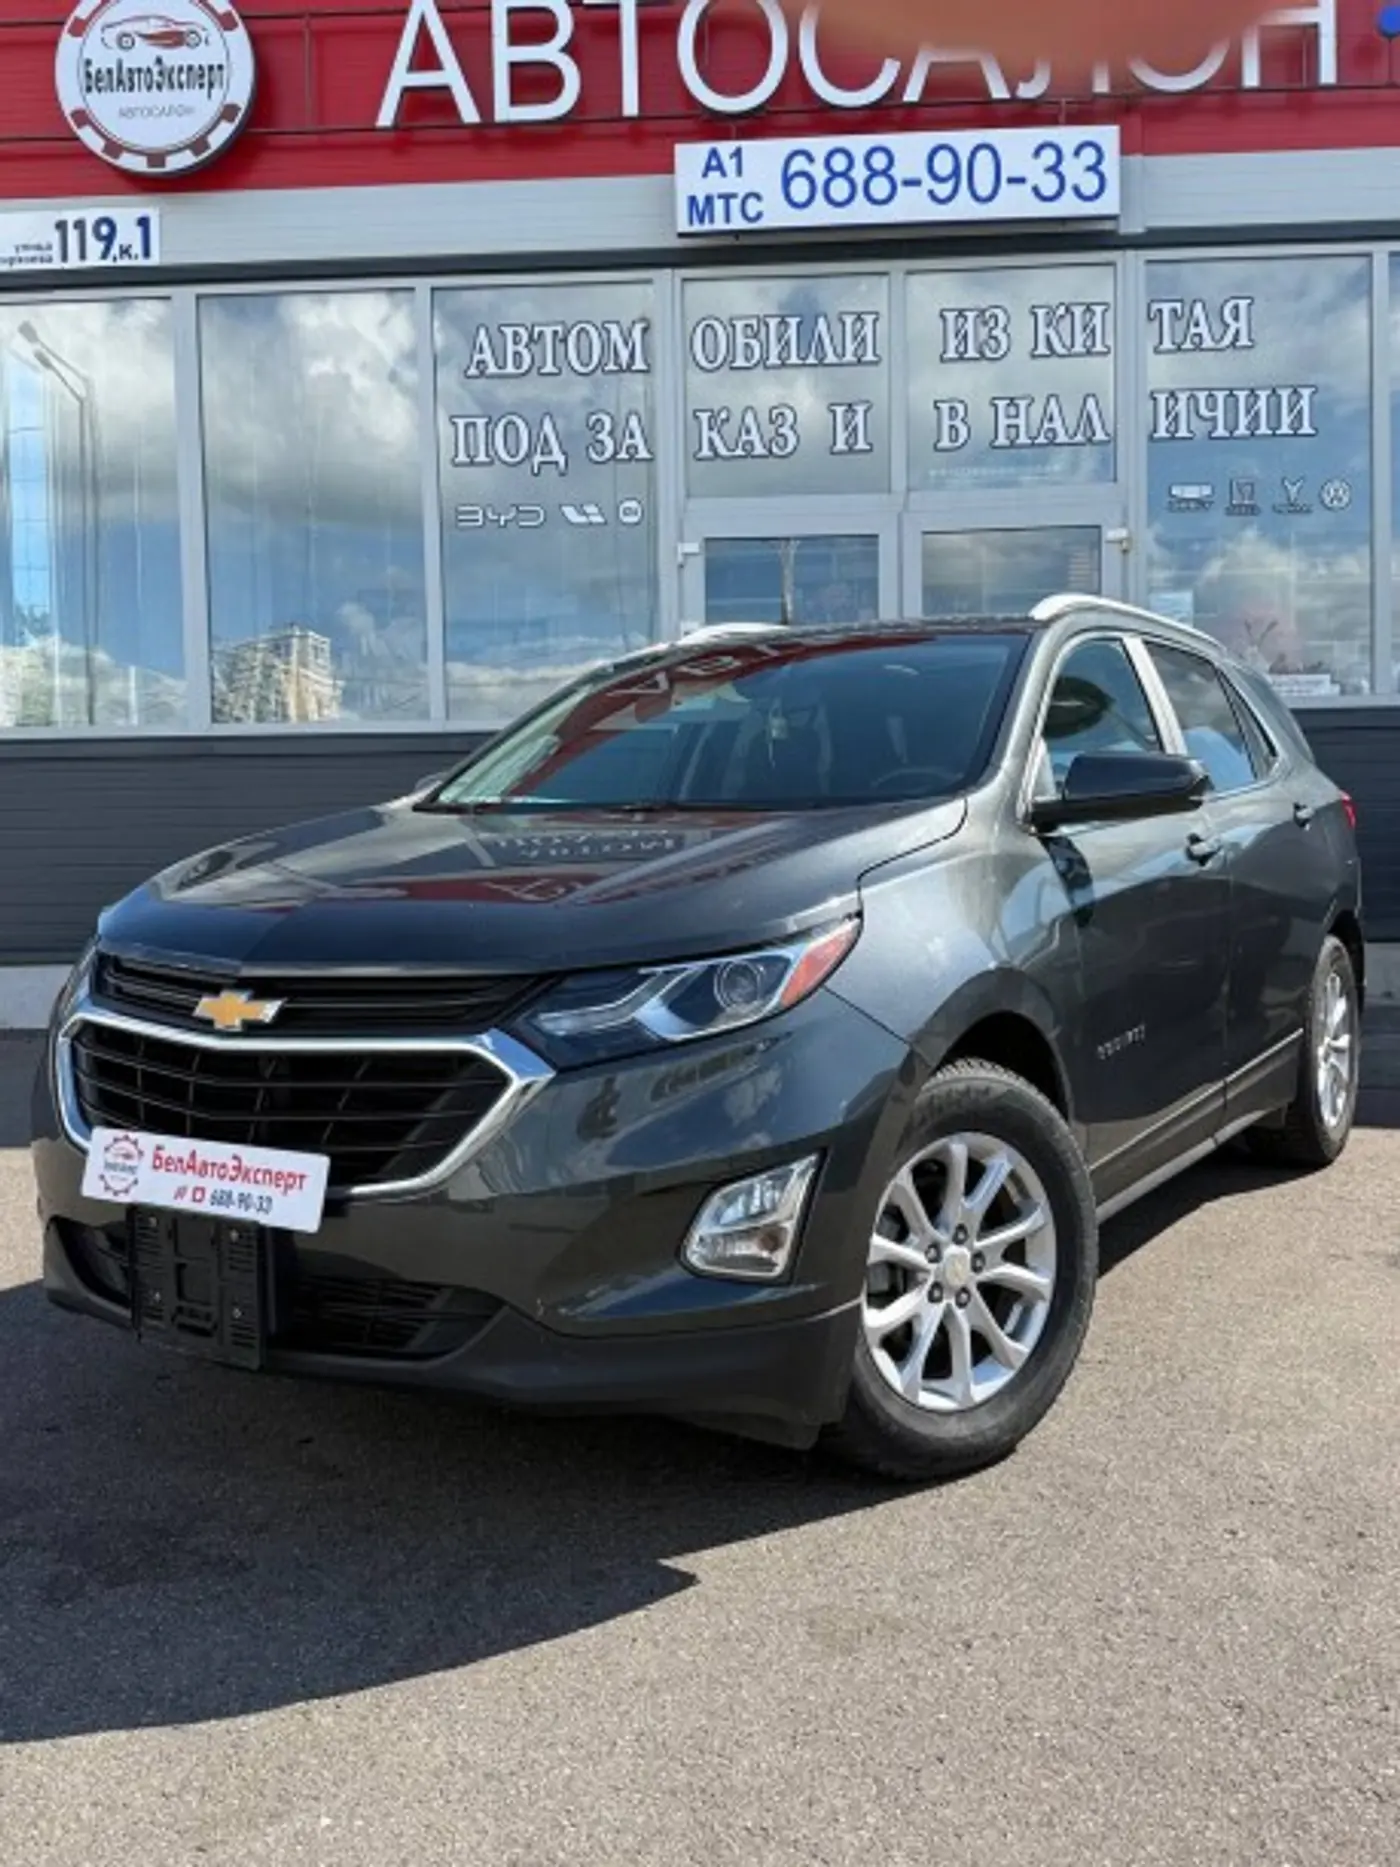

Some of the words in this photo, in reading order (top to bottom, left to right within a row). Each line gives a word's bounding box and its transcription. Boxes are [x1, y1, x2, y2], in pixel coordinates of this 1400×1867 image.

[84, 56, 225, 99] БелАвтоЭксперт
[702, 147, 744, 179] A1
[780, 140, 1108, 210] 688-90-33
[687, 191, 764, 226] МТС
[940, 306, 1010, 362] ИЗ
[451, 412, 568, 476] ПОД
[829, 402, 874, 455] И
[933, 400, 972, 452] В
[152, 1145, 309, 1196] БелАвтоЭксперт
